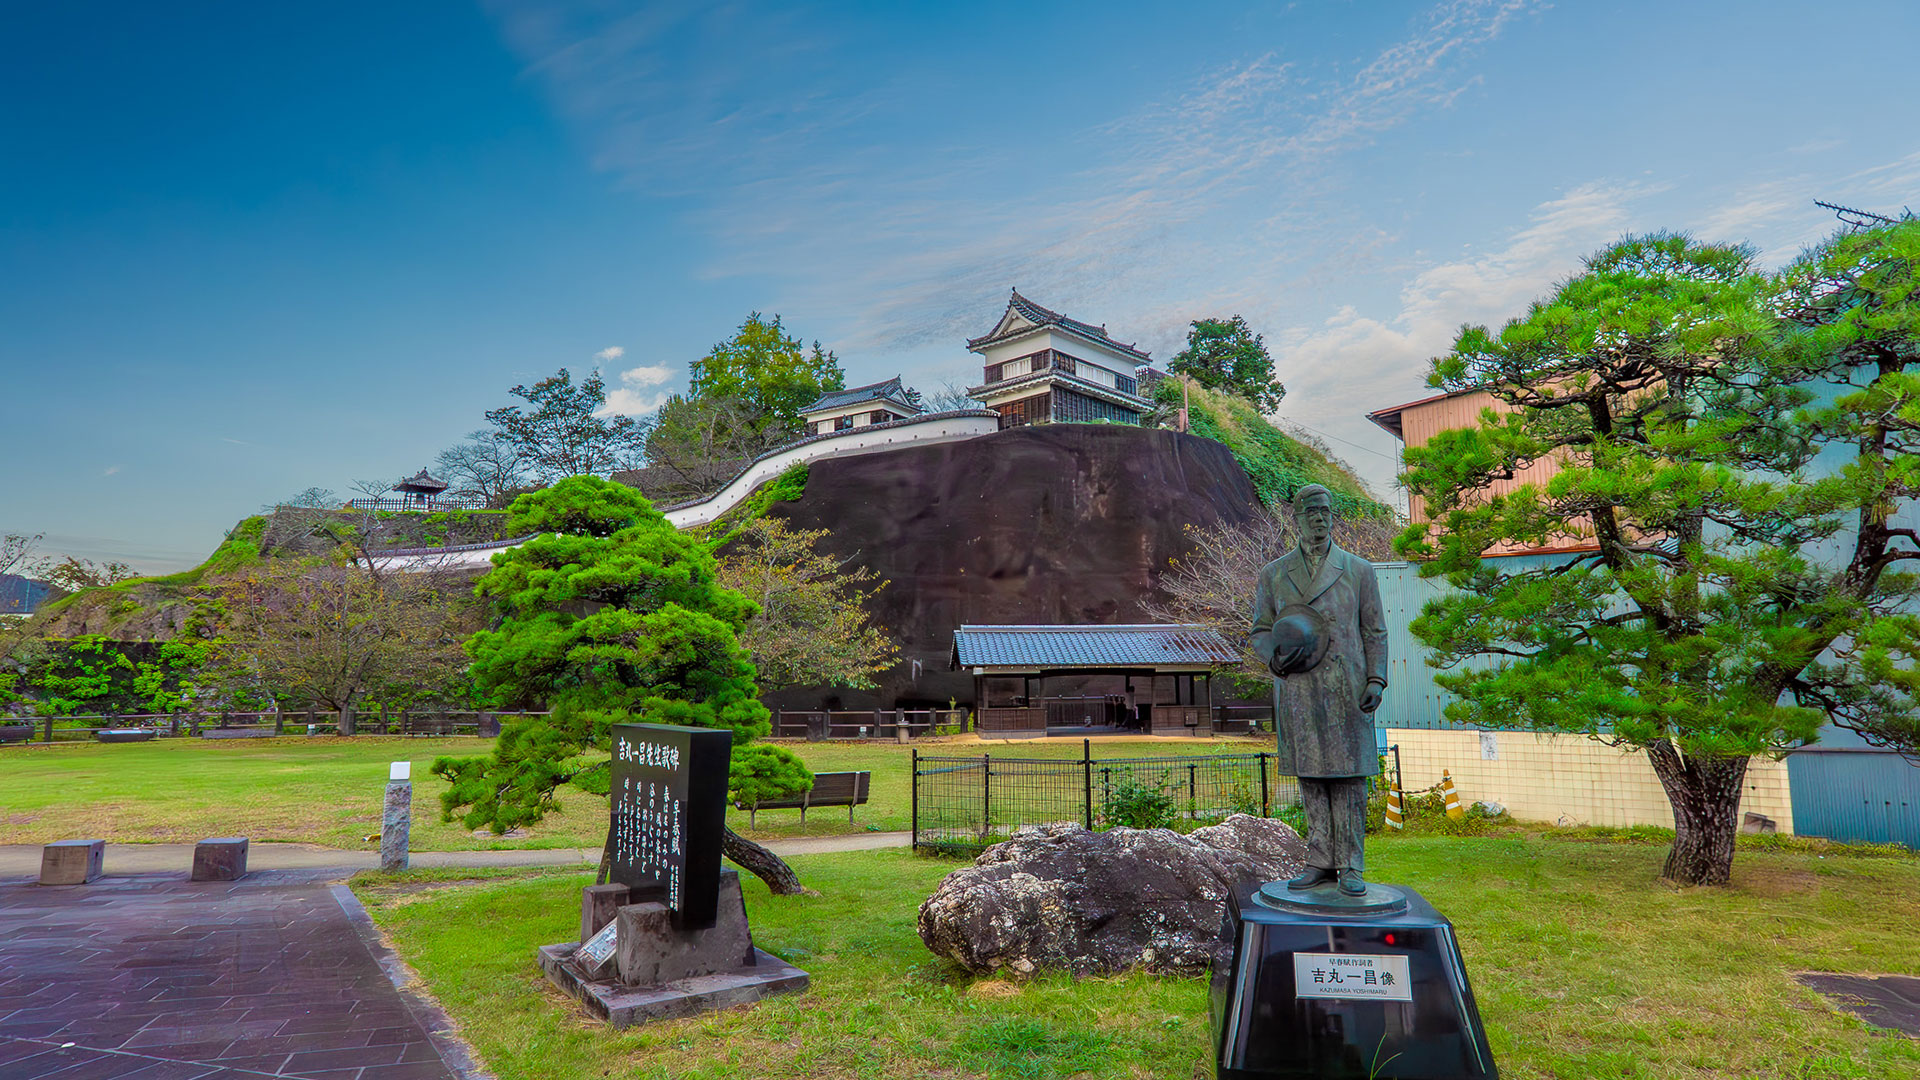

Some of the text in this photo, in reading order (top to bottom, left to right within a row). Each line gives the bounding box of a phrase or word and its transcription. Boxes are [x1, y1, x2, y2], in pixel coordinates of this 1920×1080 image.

[618, 736, 680, 771] 吉丸一昌先生歌碑
[622, 777, 630, 853] 時にあらずと
[648, 782, 656, 864] 谷のうぐいす
[662, 785, 670, 869] 春は名のみの
[671, 799, 681, 856] 早春賦
[1311, 967, 1396, 986] 吉丸一昌像
[1329, 958, 1373, 967] 早春賦作詞者
